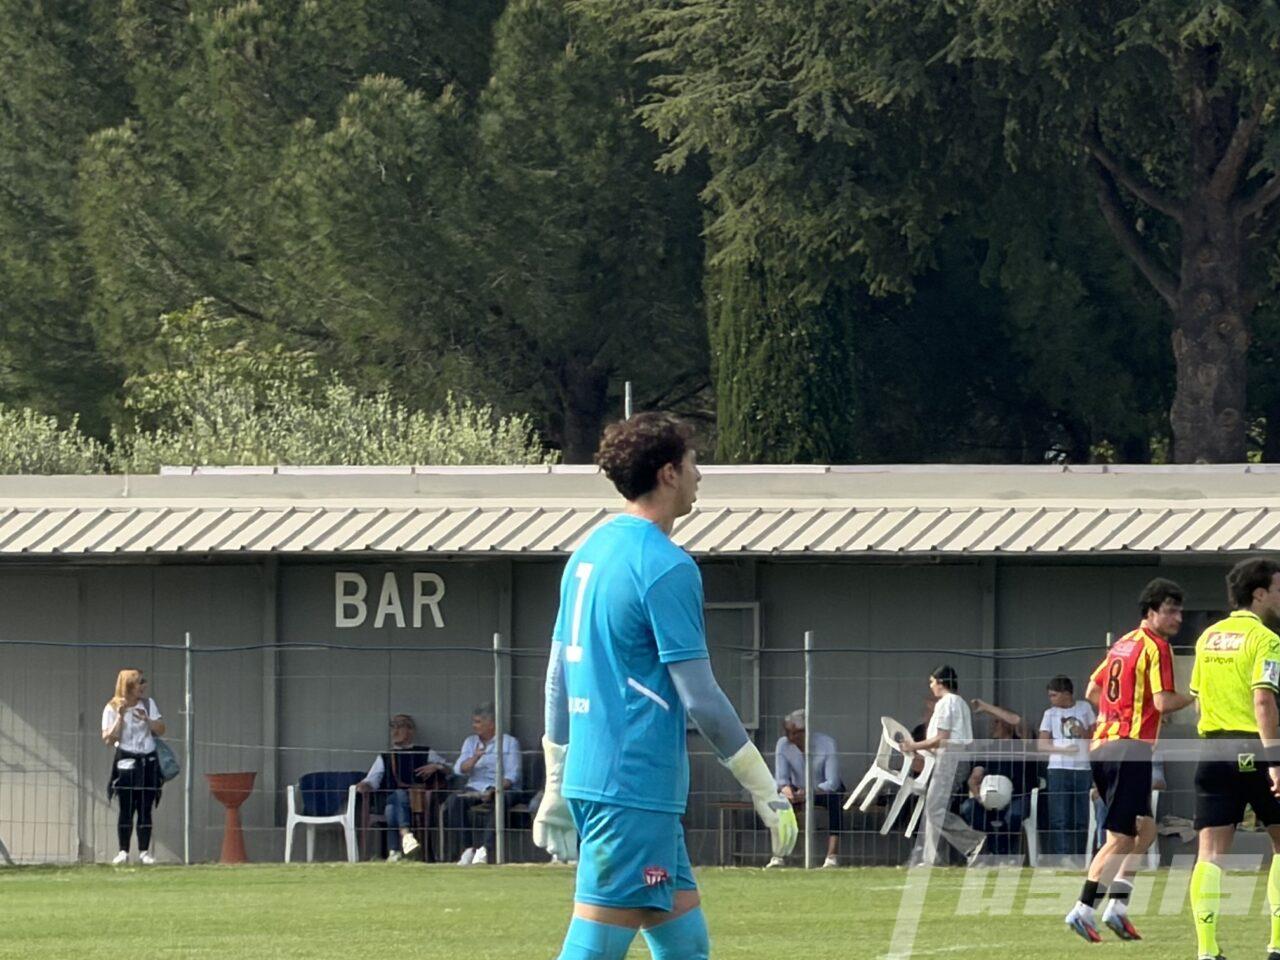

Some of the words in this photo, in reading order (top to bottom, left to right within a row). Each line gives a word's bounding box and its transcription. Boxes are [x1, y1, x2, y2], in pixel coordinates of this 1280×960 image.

[335, 571, 446, 629] BAR
[566, 562, 595, 663] 1
[1106, 657, 1124, 704] 8
